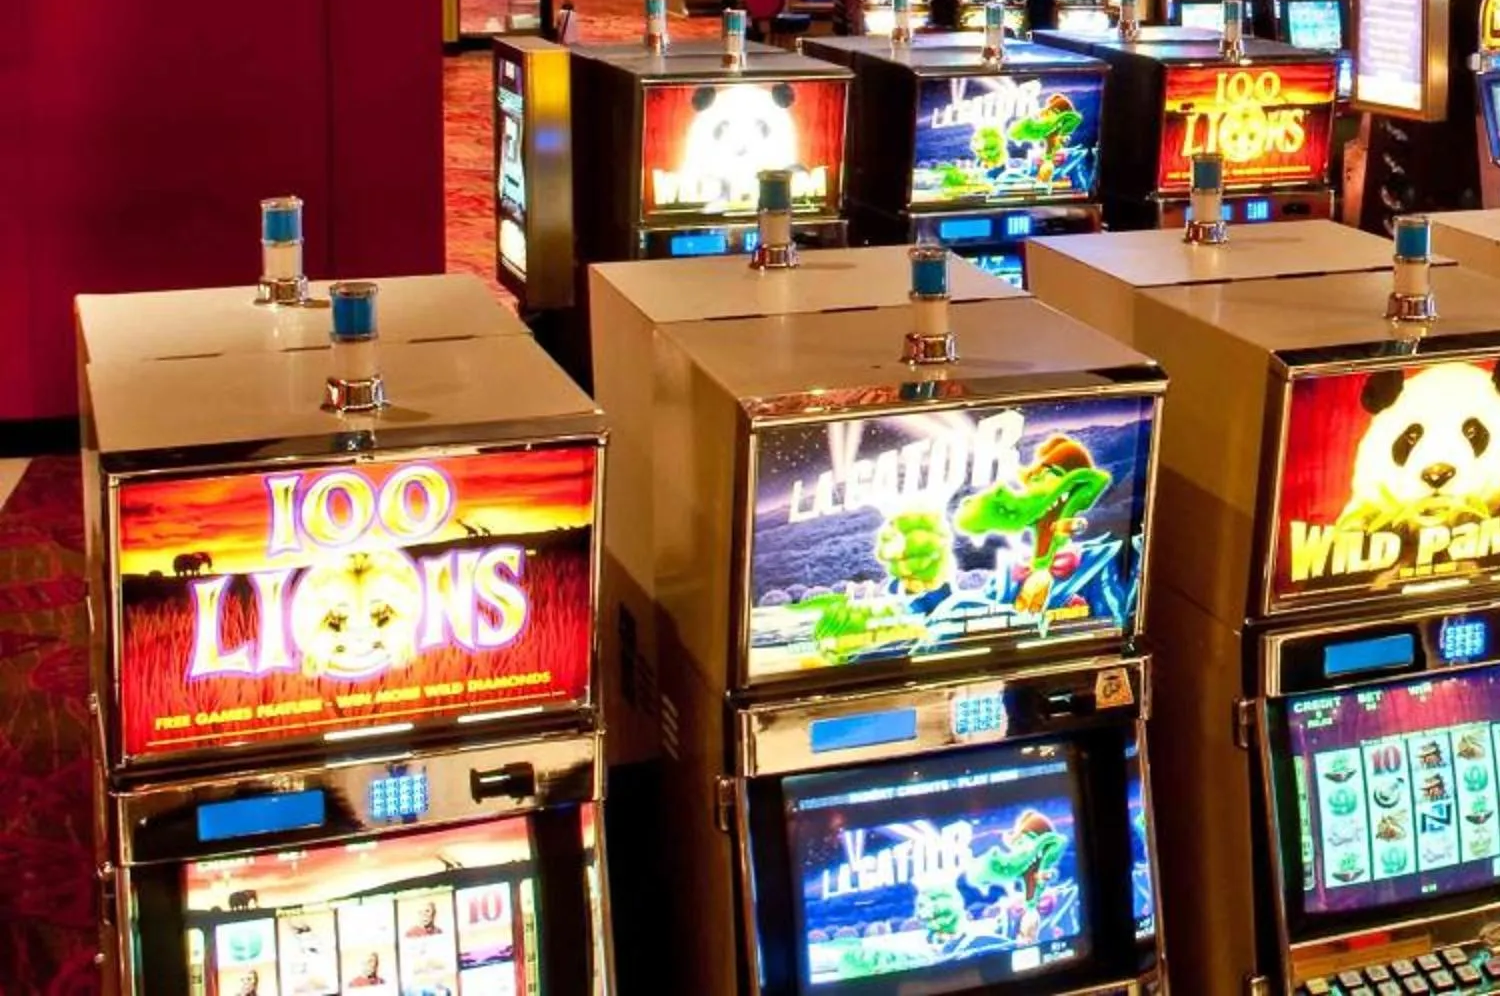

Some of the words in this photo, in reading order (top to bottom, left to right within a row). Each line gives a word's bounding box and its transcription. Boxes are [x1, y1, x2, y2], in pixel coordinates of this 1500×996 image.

[1215, 71, 1281, 104] 100
[1182, 105, 1305, 162] LIONS
[265, 464, 458, 558] 100
[1290, 520, 1402, 582] WILD
[186, 544, 530, 682] LIONS
